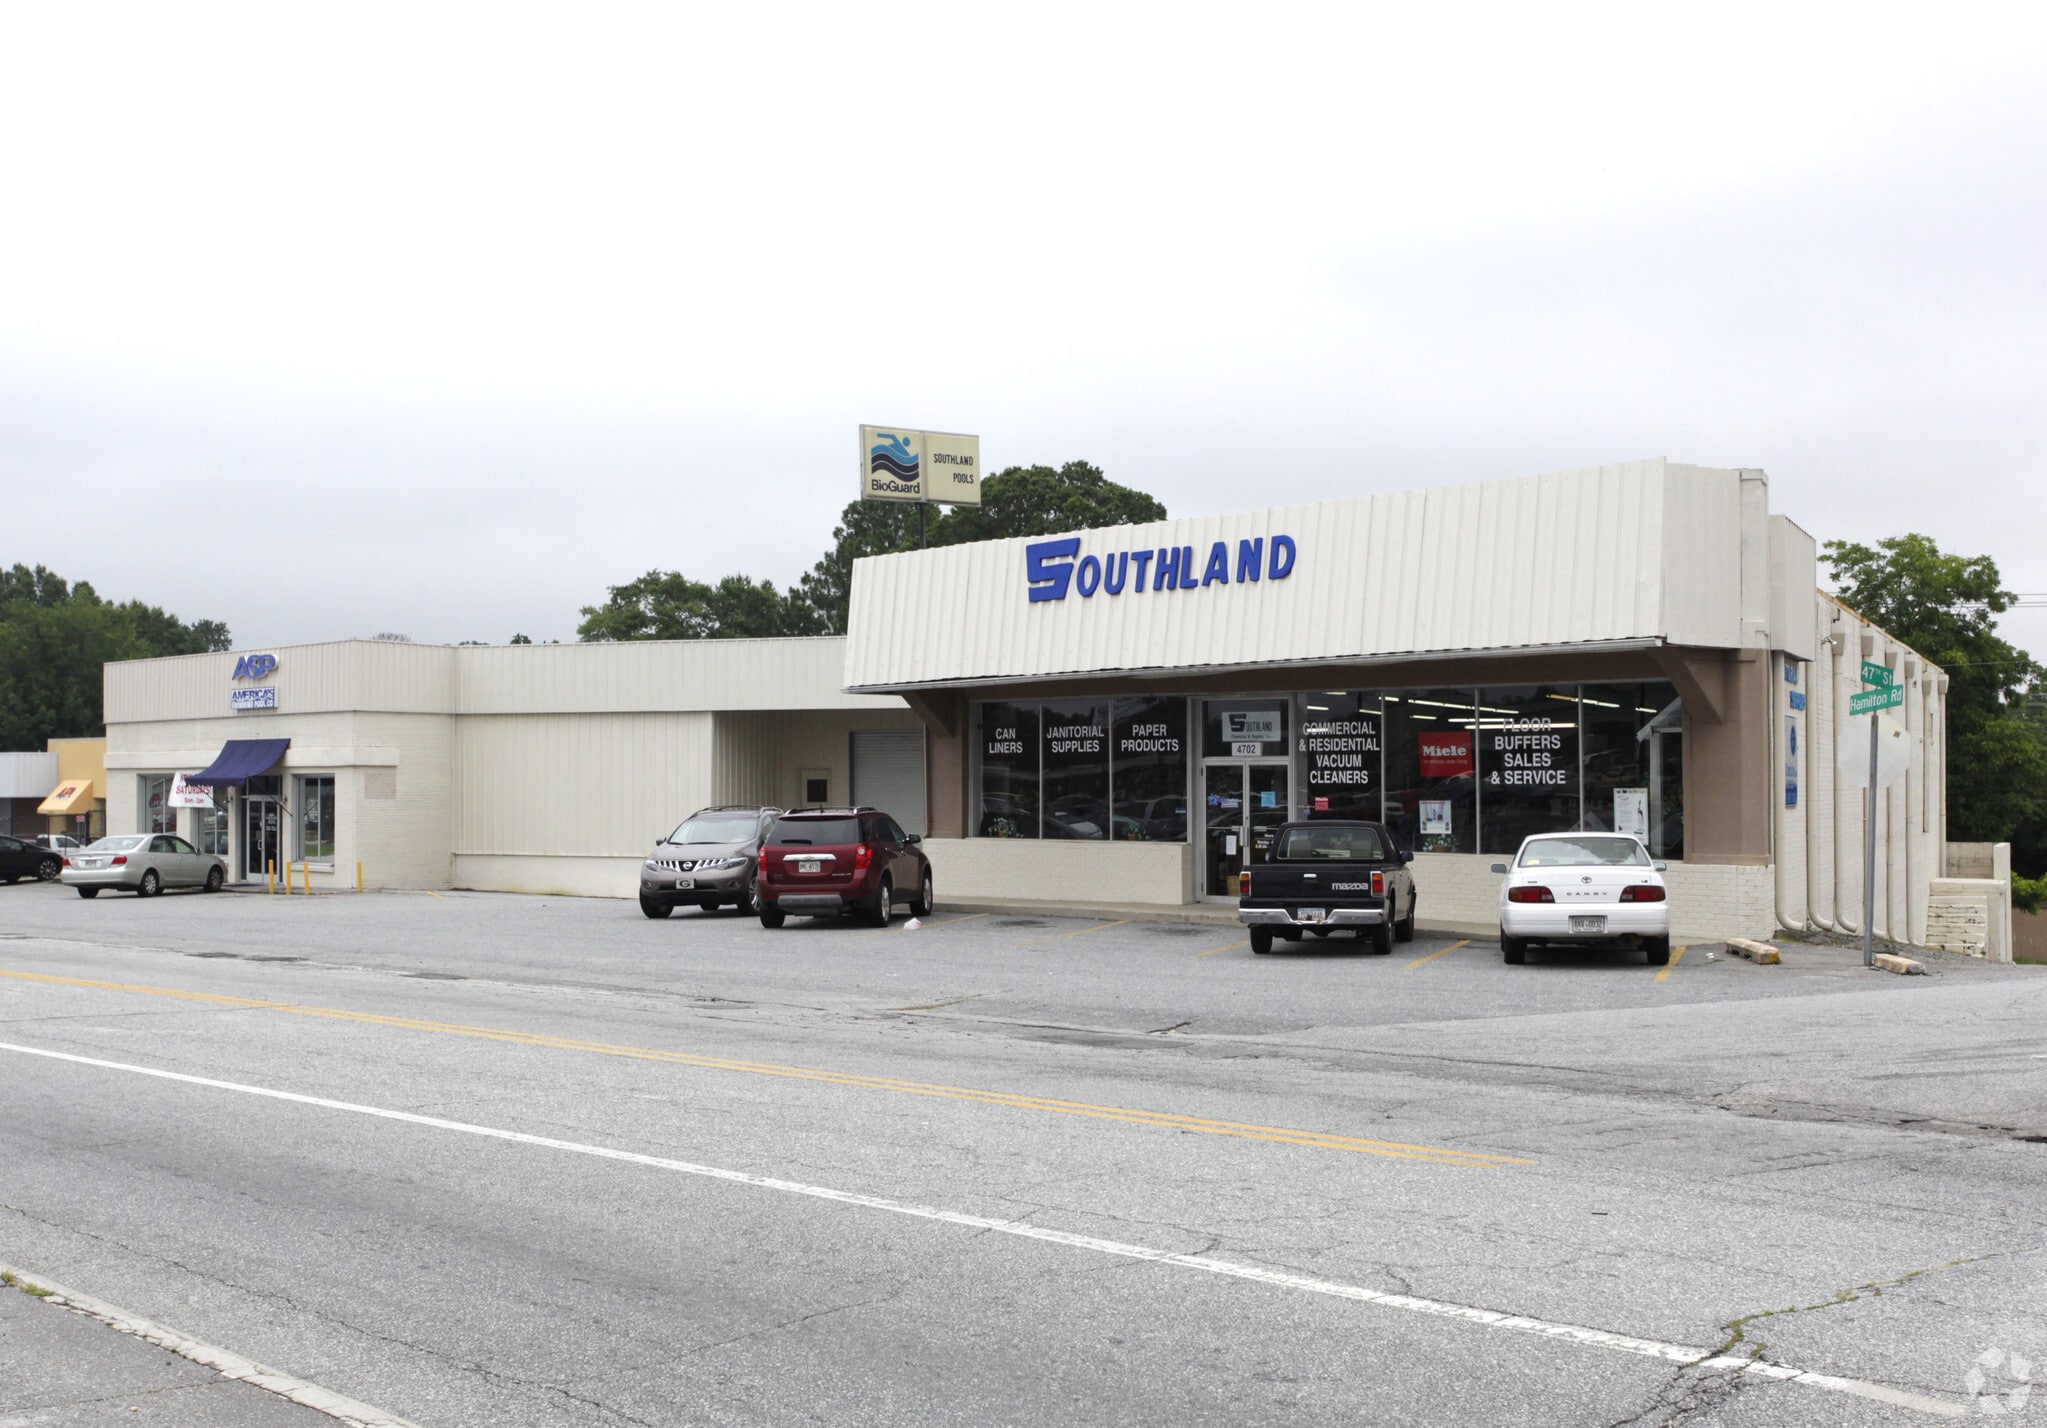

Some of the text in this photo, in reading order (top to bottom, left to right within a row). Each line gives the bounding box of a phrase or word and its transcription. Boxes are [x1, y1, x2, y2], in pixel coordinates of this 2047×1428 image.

[933, 453, 974, 466] SOUTHLAND
[953, 472, 974, 485] POOLS
[871, 478, 920, 494] BioGuard
[1026, 535, 1296, 602] SOUTHLAND
[232, 654, 277, 681] ASP
[1882, 672, 1893, 686] St
[1850, 688, 1903, 712] Hamilton Rd
[1132, 724, 1167, 736] PAPER
[1229, 713, 1273, 733] SOUTHLAND
[1303, 721, 1376, 735] COMMERCIAL
[1503, 717, 1551, 732] FLOOR
[995, 728, 1016, 739] CAN
[1047, 726, 1105, 738] JANITORIAL
[989, 741, 1023, 754] LINERS
[1051, 740, 1100, 753] SUPPLIES
[1121, 739, 1179, 752] PRODUCTS
[1237, 744, 1256, 754] 4702
[1299, 738, 1380, 751] & RESIDENTIAL
[1495, 735, 1561, 750] BUFFERS
[1423, 745, 1467, 757] Miele
[1316, 754, 1362, 768] VACUUM
[1504, 752, 1551, 767] SALES
[1309, 770, 1369, 784] CLEANERS
[1491, 769, 1566, 785] & SERVICE
[1331, 882, 1369, 891] mazda
